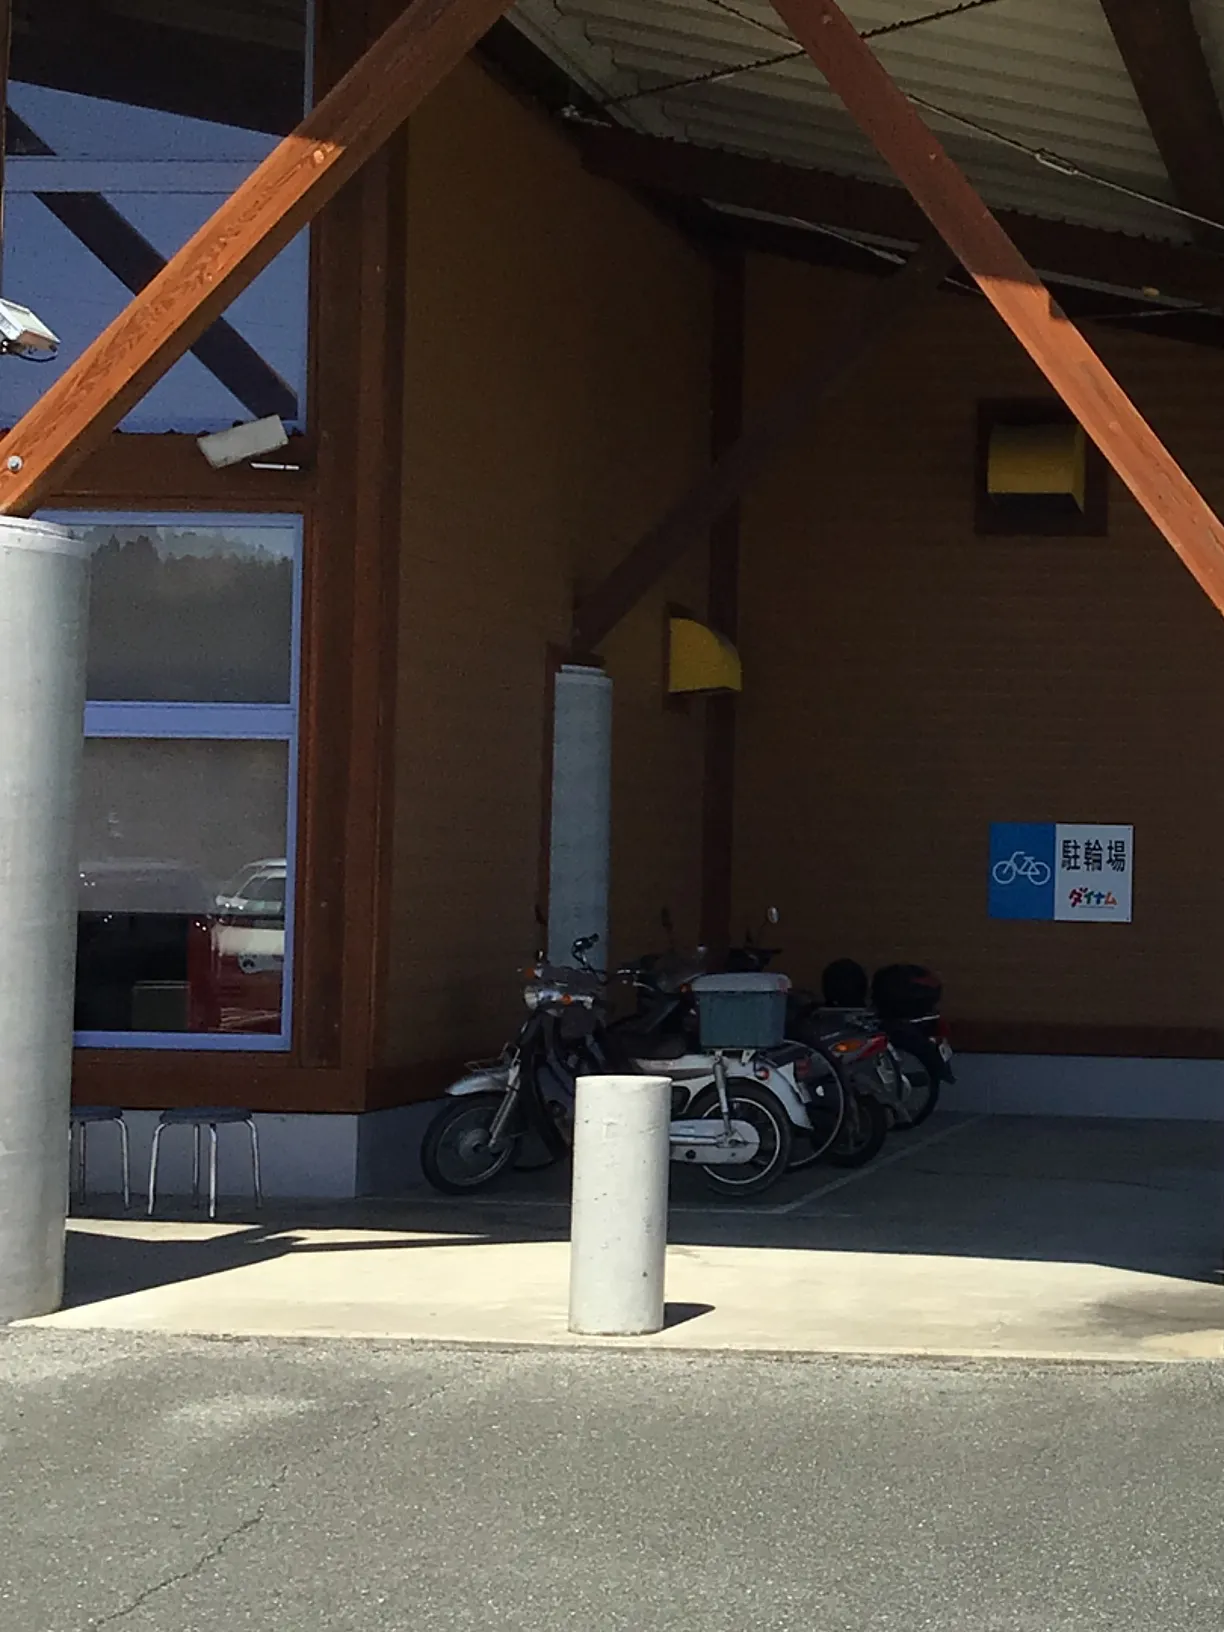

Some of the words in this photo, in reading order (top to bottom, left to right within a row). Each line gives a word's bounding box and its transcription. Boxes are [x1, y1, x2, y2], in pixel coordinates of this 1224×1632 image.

[1061, 839, 1126, 872] 駐輪場
[1069, 887, 1118, 908] ダイナム
